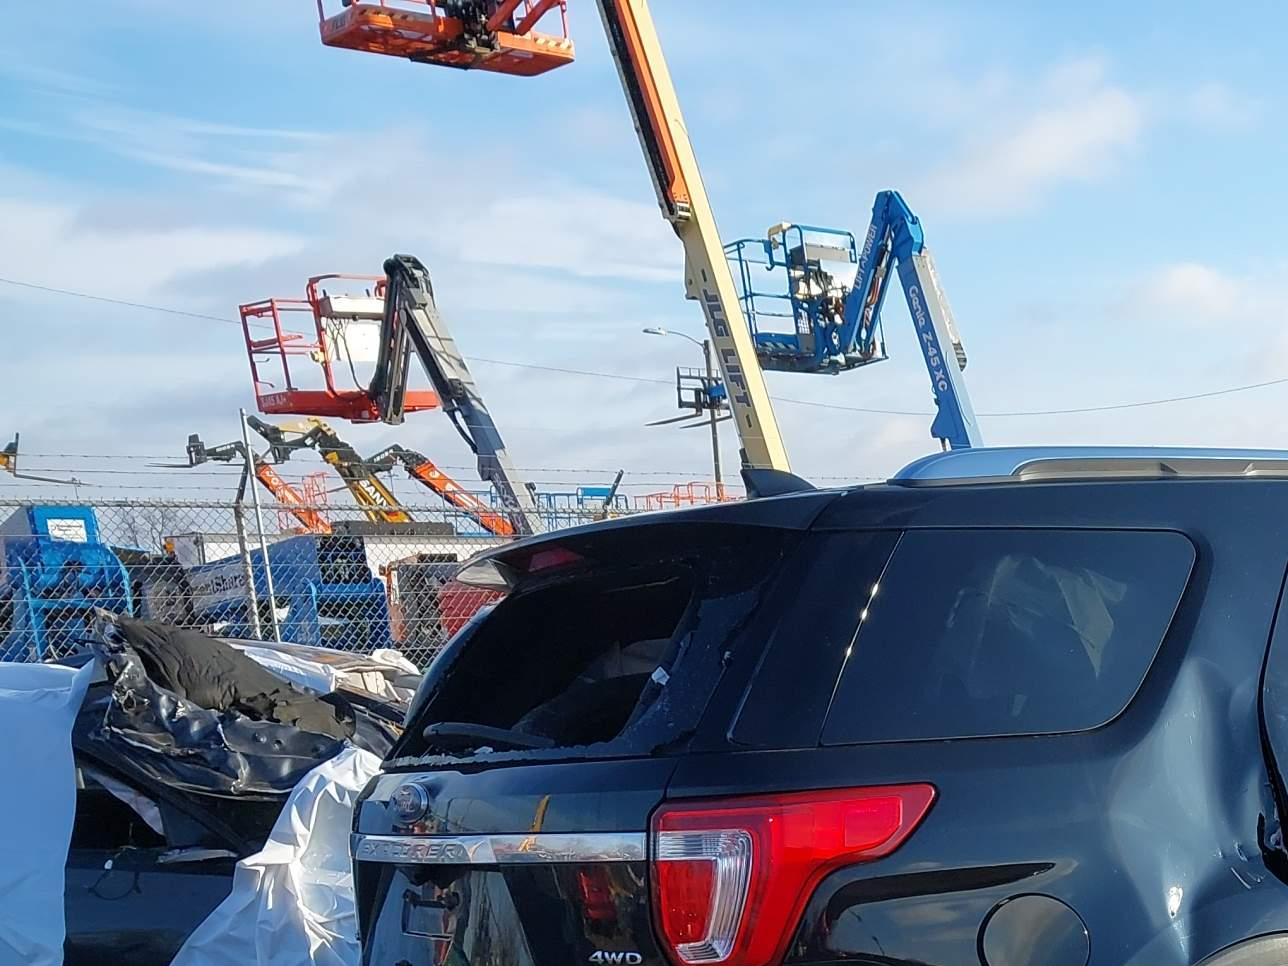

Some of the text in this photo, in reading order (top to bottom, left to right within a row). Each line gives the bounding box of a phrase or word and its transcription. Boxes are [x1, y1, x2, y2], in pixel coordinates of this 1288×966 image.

[703, 288, 752, 408] JLG LIFT
[908, 285, 948, 392] Genie Z-45 XC
[588, 950, 642, 965] 4WD
